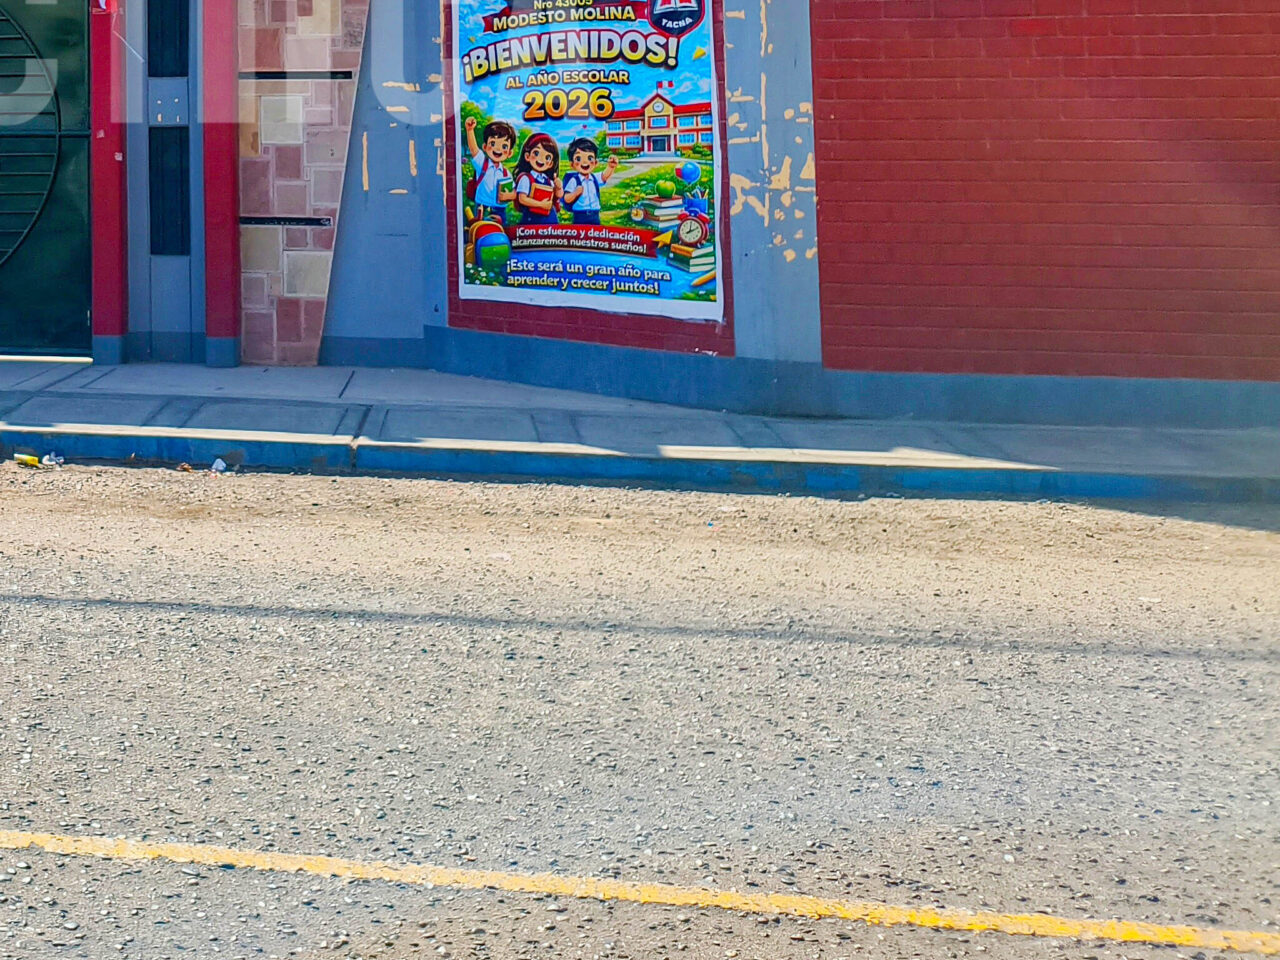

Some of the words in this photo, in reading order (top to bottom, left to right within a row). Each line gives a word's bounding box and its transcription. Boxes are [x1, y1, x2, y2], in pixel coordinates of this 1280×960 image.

[533, 0, 553, 10] Nro
[493, 10, 566, 31] MODESTO
[570, 5, 636, 21] MOLINA
[662, 17, 693, 29] TACNA
[463, 30, 680, 82] ¡BIENVENIDOS!
[506, 77, 523, 89] AL
[527, 71, 559, 86] AÑO
[563, 70, 629, 83] ESCOLAR
[524, 89, 613, 119] 2026
[516, 227, 536, 236] ¡Con
[538, 227, 577, 236] esfuerzo
[580, 229, 585, 237] y
[588, 229, 640, 242] dedicación
[512, 238, 568, 247] alcanzaremos
[570, 239, 609, 248] nuestros
[611, 241, 647, 253] sueños!
[506, 259, 535, 273] ¡Este
[537, 260, 563, 272] será
[566, 263, 583, 273] un
[586, 265, 616, 276] gran
[618, 264, 641, 277] año
[644, 270, 671, 281] para
[507, 274, 560, 286] aprender
[561, 278, 568, 289] y
[571, 280, 609, 289] crecer
[611, 279, 660, 294] juntos!
